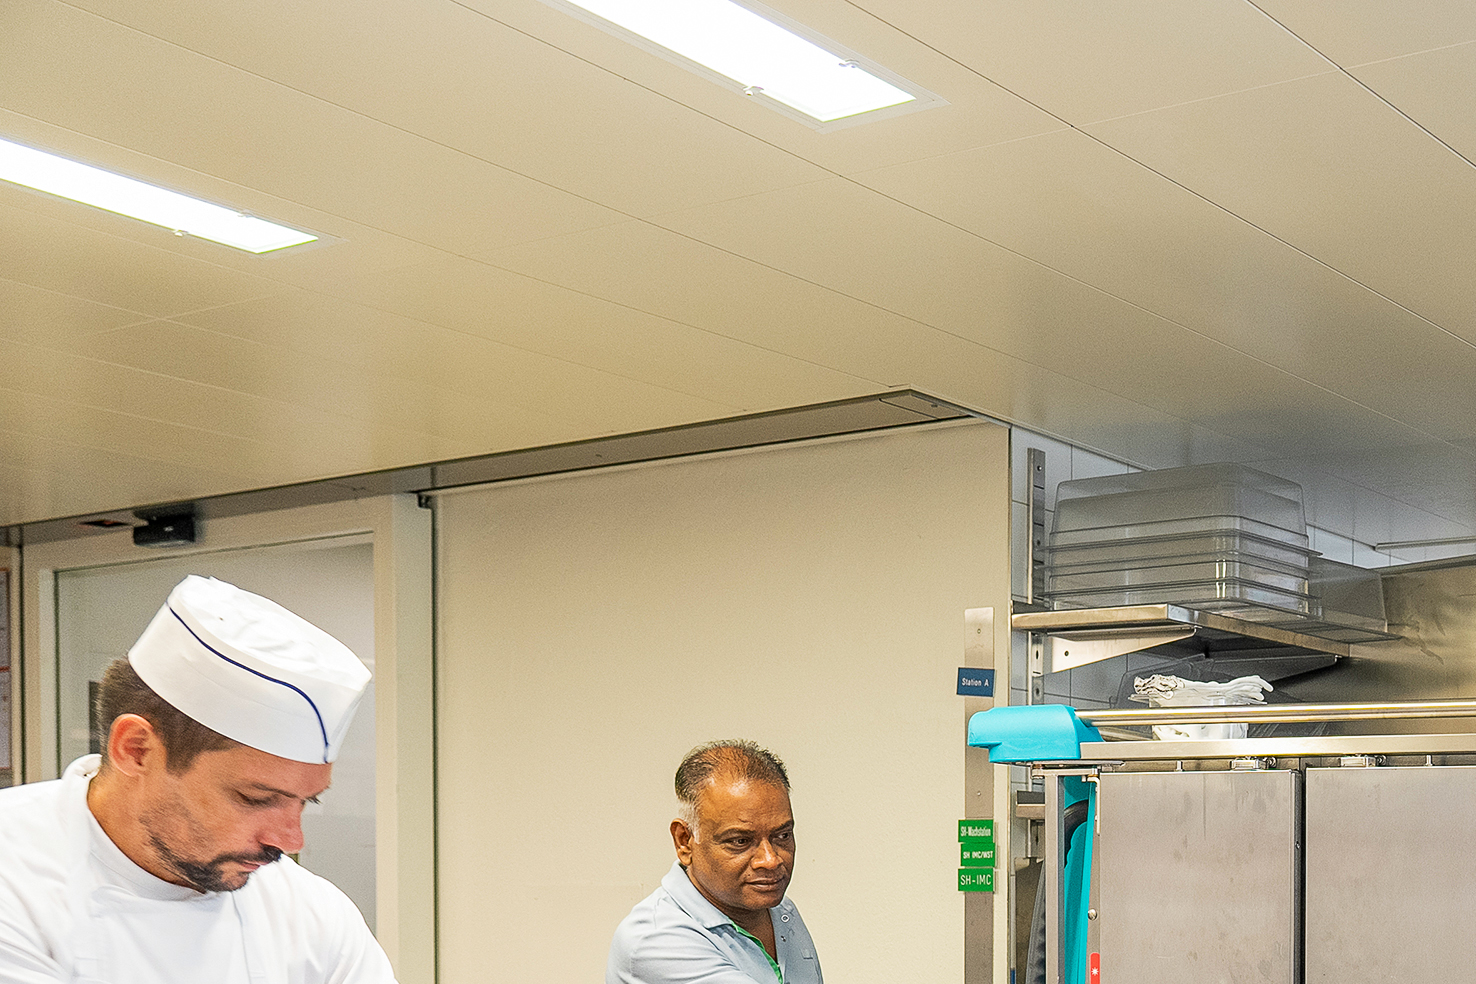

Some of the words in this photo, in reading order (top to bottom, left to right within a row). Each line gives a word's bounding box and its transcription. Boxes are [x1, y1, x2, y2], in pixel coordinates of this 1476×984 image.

[961, 677, 982, 686] Station
[984, 678, 989, 687] A
[963, 851, 971, 859] SH
[972, 850, 993, 859] IMC/WST
[960, 874, 991, 886] SH-IMC
